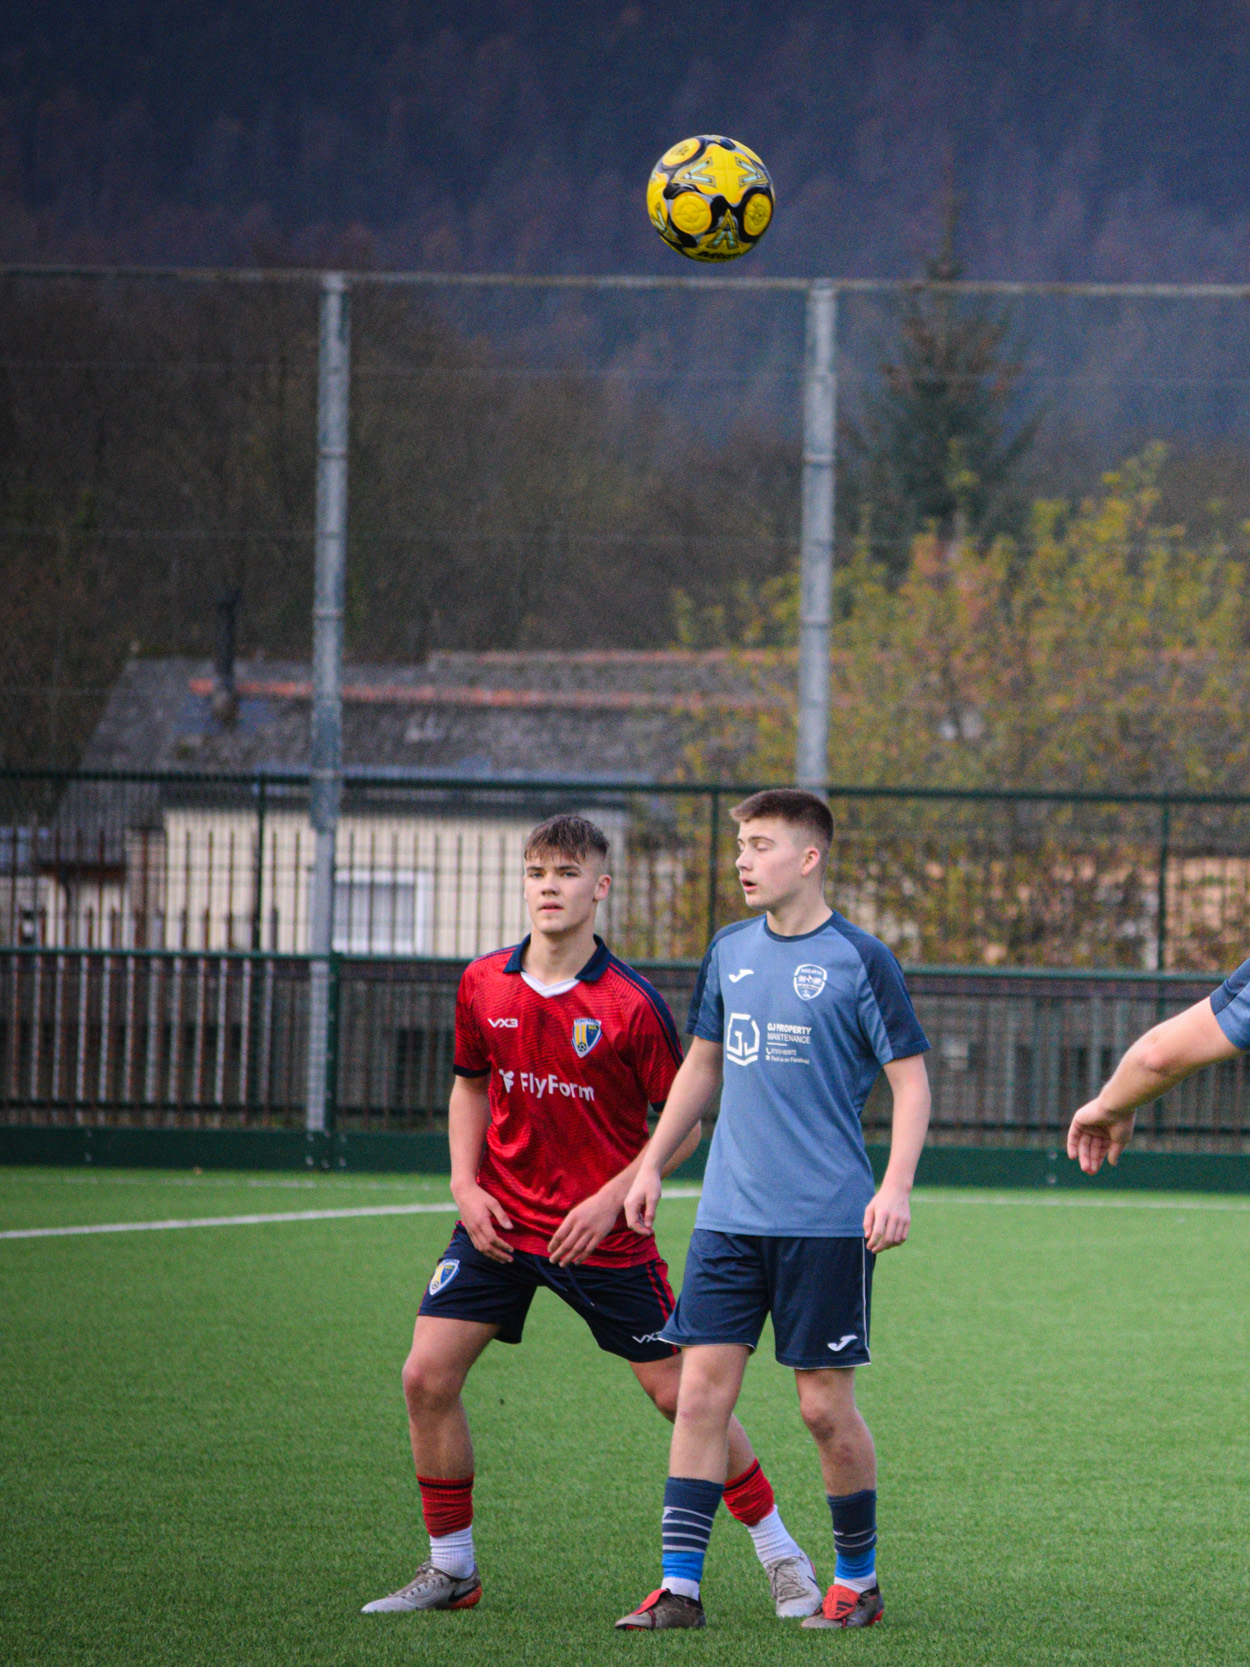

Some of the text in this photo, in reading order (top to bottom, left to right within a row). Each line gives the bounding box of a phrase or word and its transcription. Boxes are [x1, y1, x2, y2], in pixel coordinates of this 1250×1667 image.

[487, 1018, 519, 1028] VX3
[777, 1023, 812, 1035] PROPERTY
[520, 1072, 595, 1101] FlyForm
